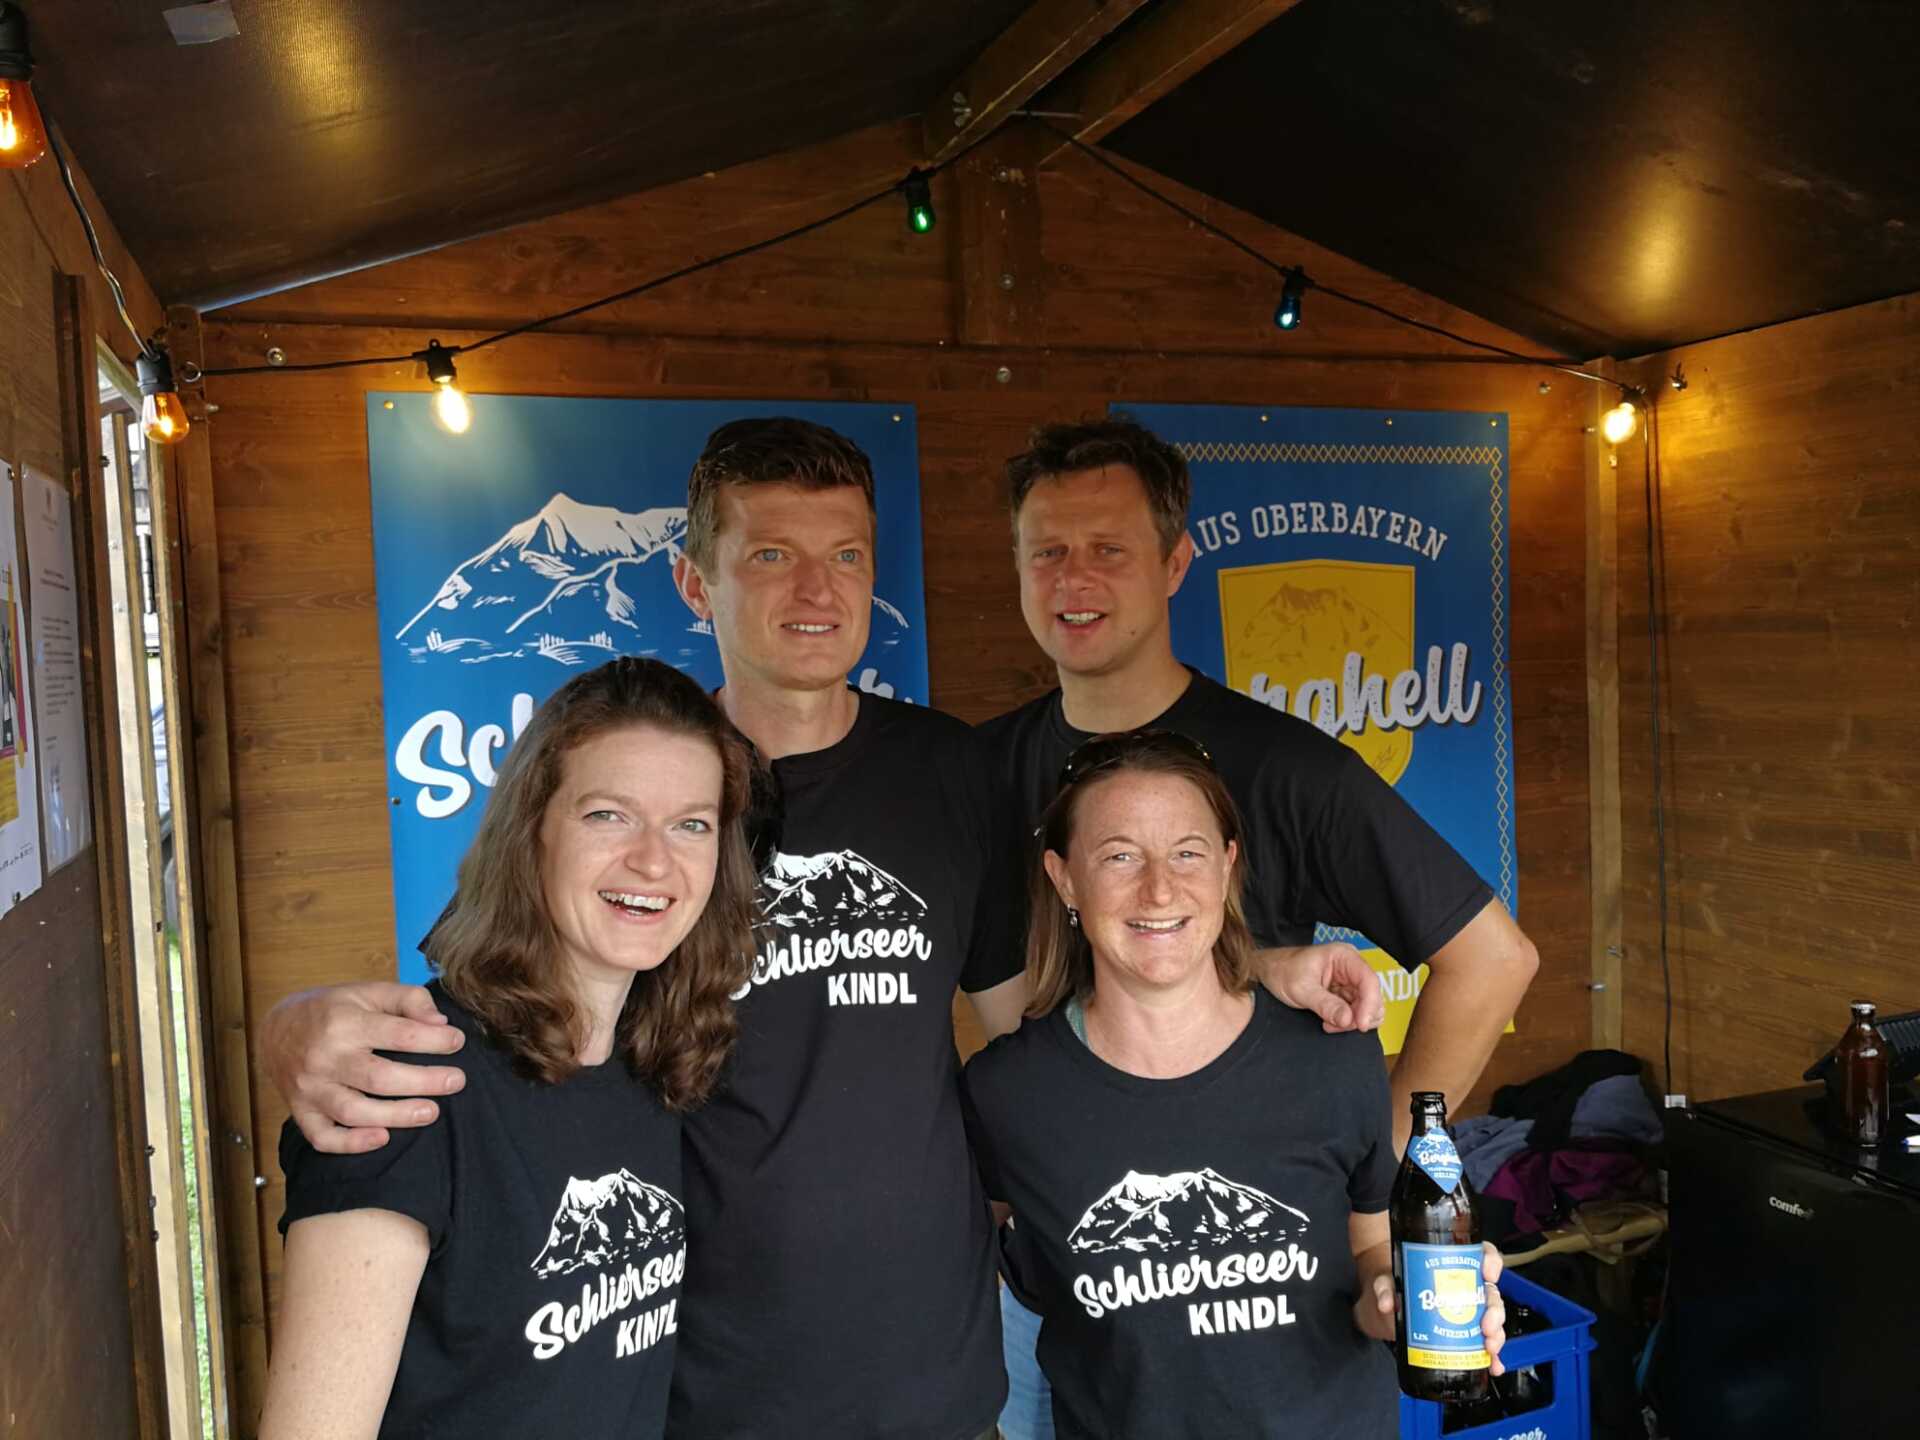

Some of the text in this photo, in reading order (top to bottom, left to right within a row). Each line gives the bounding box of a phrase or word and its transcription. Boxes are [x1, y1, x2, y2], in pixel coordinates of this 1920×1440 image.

[1251, 501, 1448, 562] OBERBAYERN
[1233, 642, 1482, 738] rghell
[828, 972, 917, 1006] KINDL
[1376, 968, 1421, 1001] NDL
[525, 1241, 687, 1360] Schliersee
[1073, 1243, 1319, 1318] Schlierseer
[1188, 1295, 1296, 1336] KINDL
